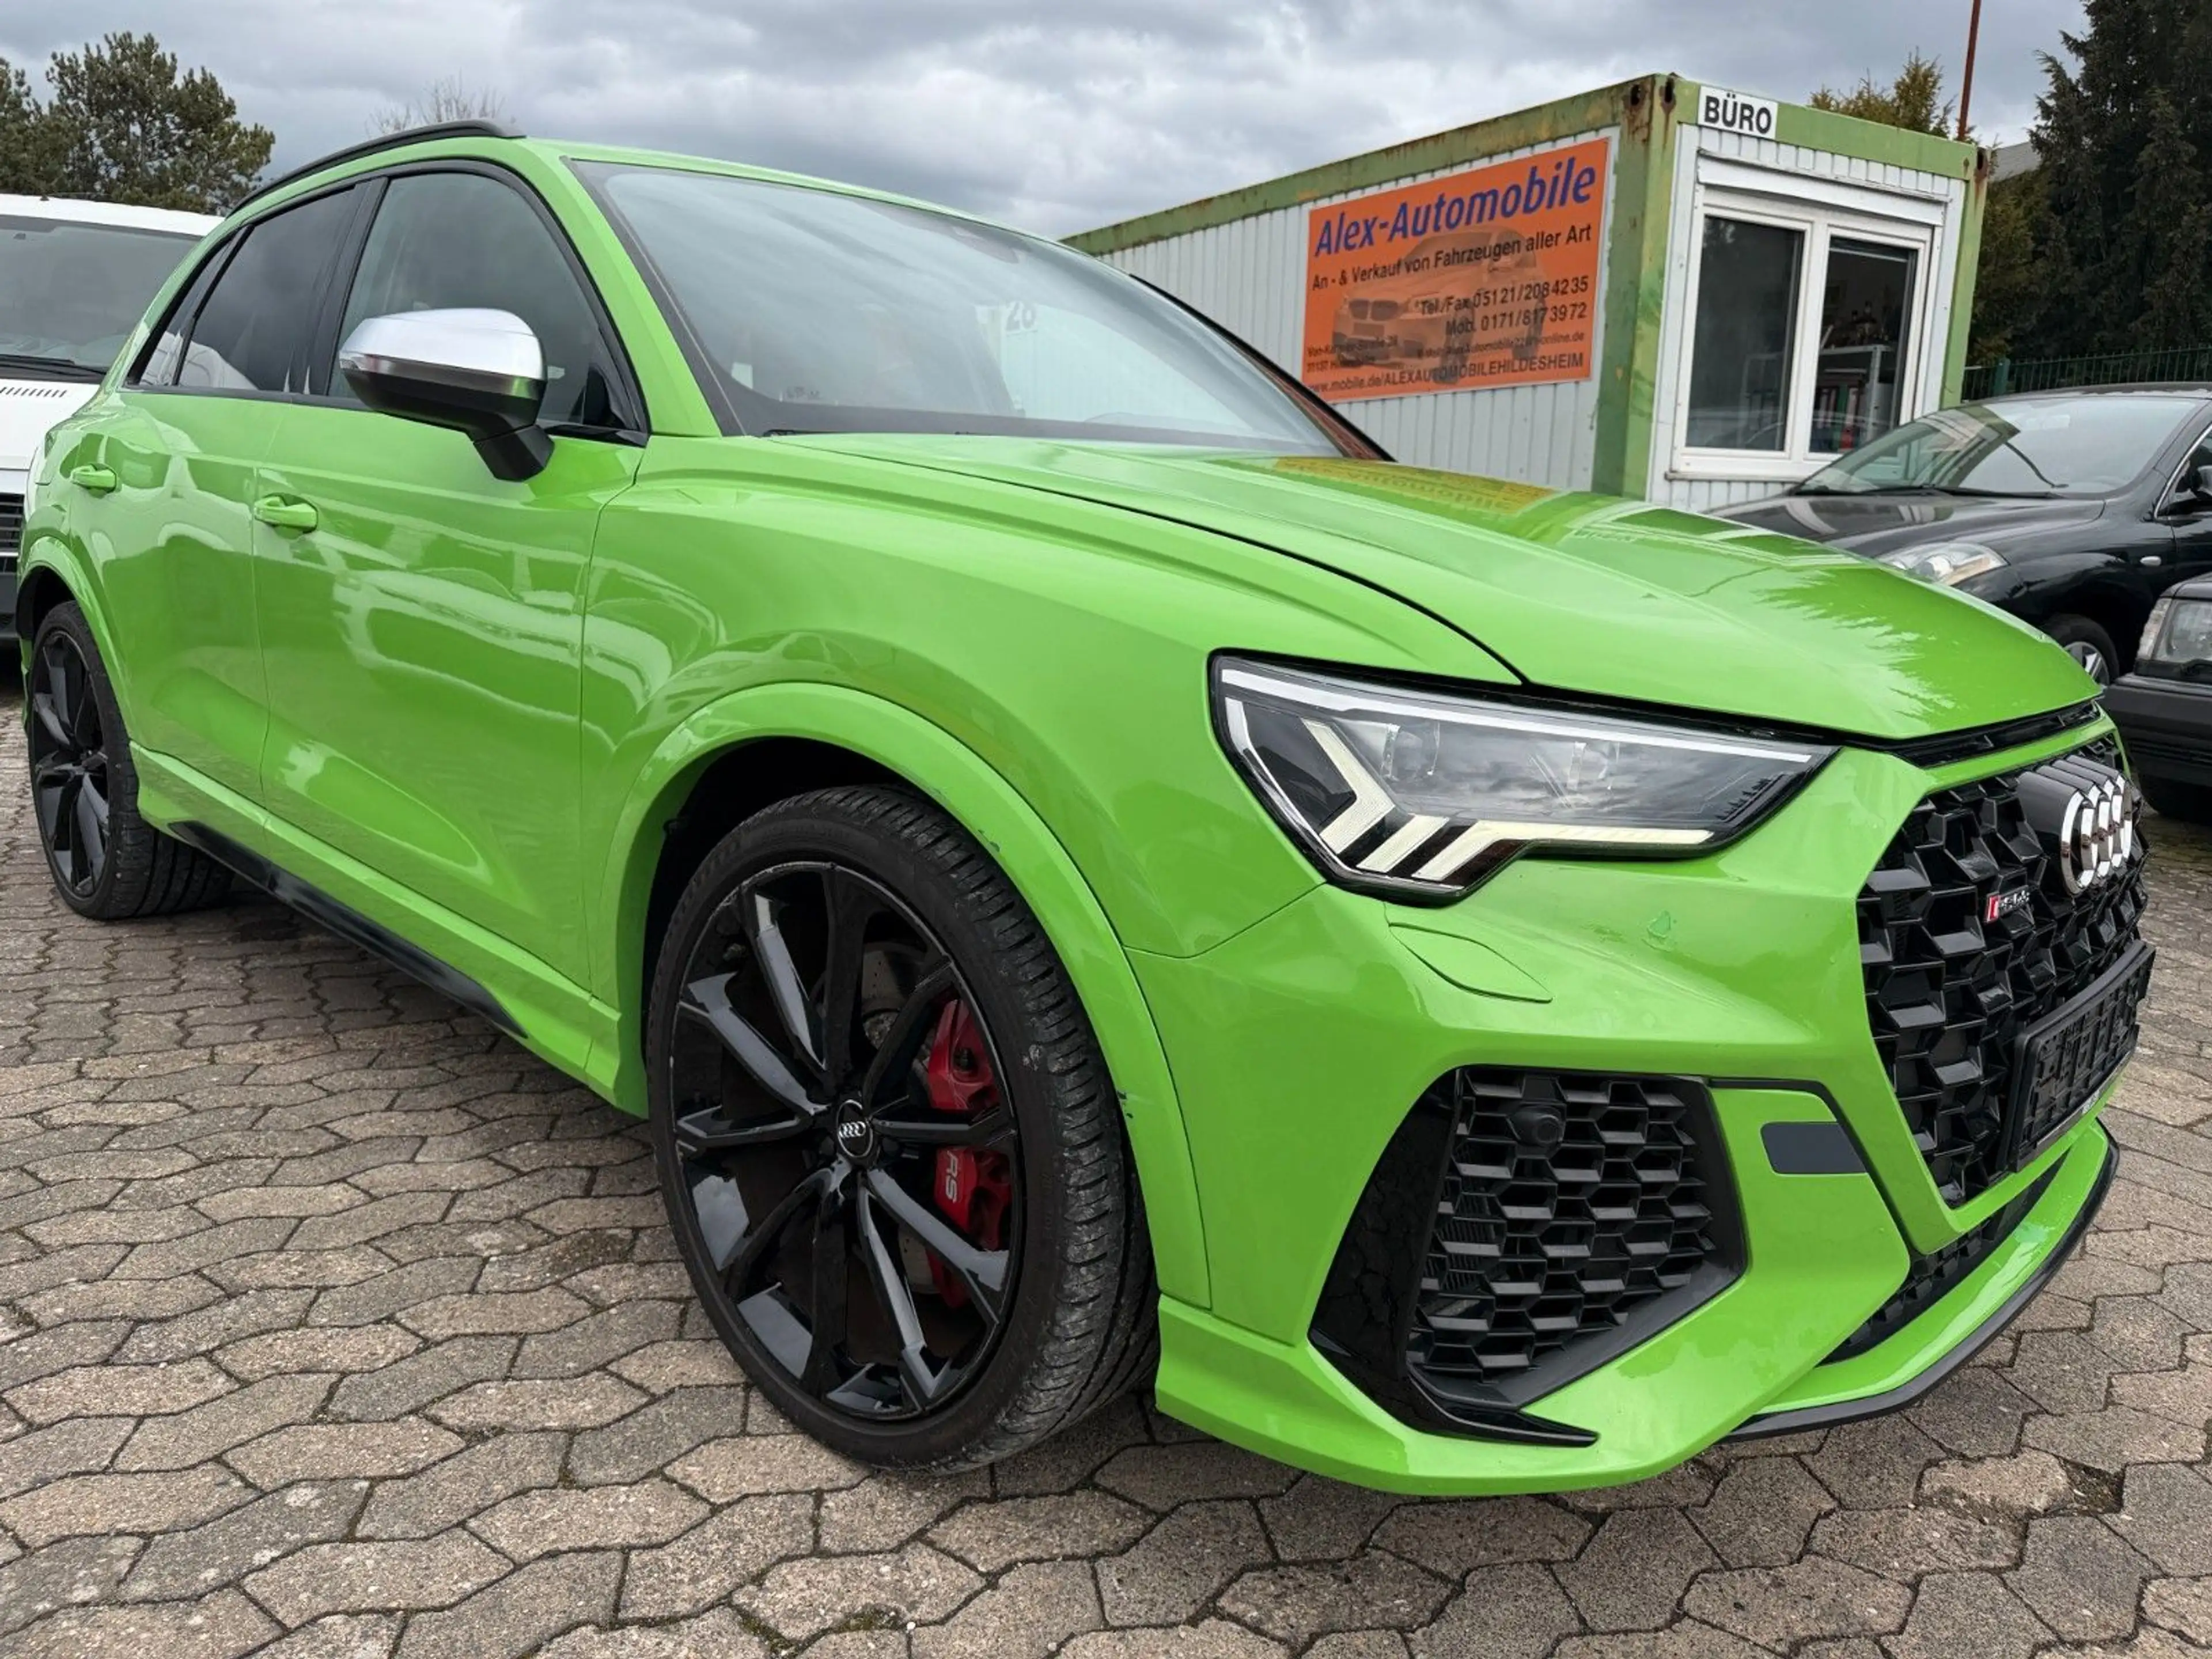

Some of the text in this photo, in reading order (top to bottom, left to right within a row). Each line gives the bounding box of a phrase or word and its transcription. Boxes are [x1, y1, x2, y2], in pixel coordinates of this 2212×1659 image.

[1705, 93, 1772, 134] BÜRO
[1315, 156, 1596, 257] Alex-Automobile
[1338, 268, 1348, 286] &
[1352, 257, 1402, 283] Verkauf
[1404, 256, 1430, 274] von
[1433, 237, 1521, 268] Fahrzeugen
[1525, 232, 1562, 252] aller
[1566, 224, 1592, 245] Art
[945, 1150, 958, 1204] RS
